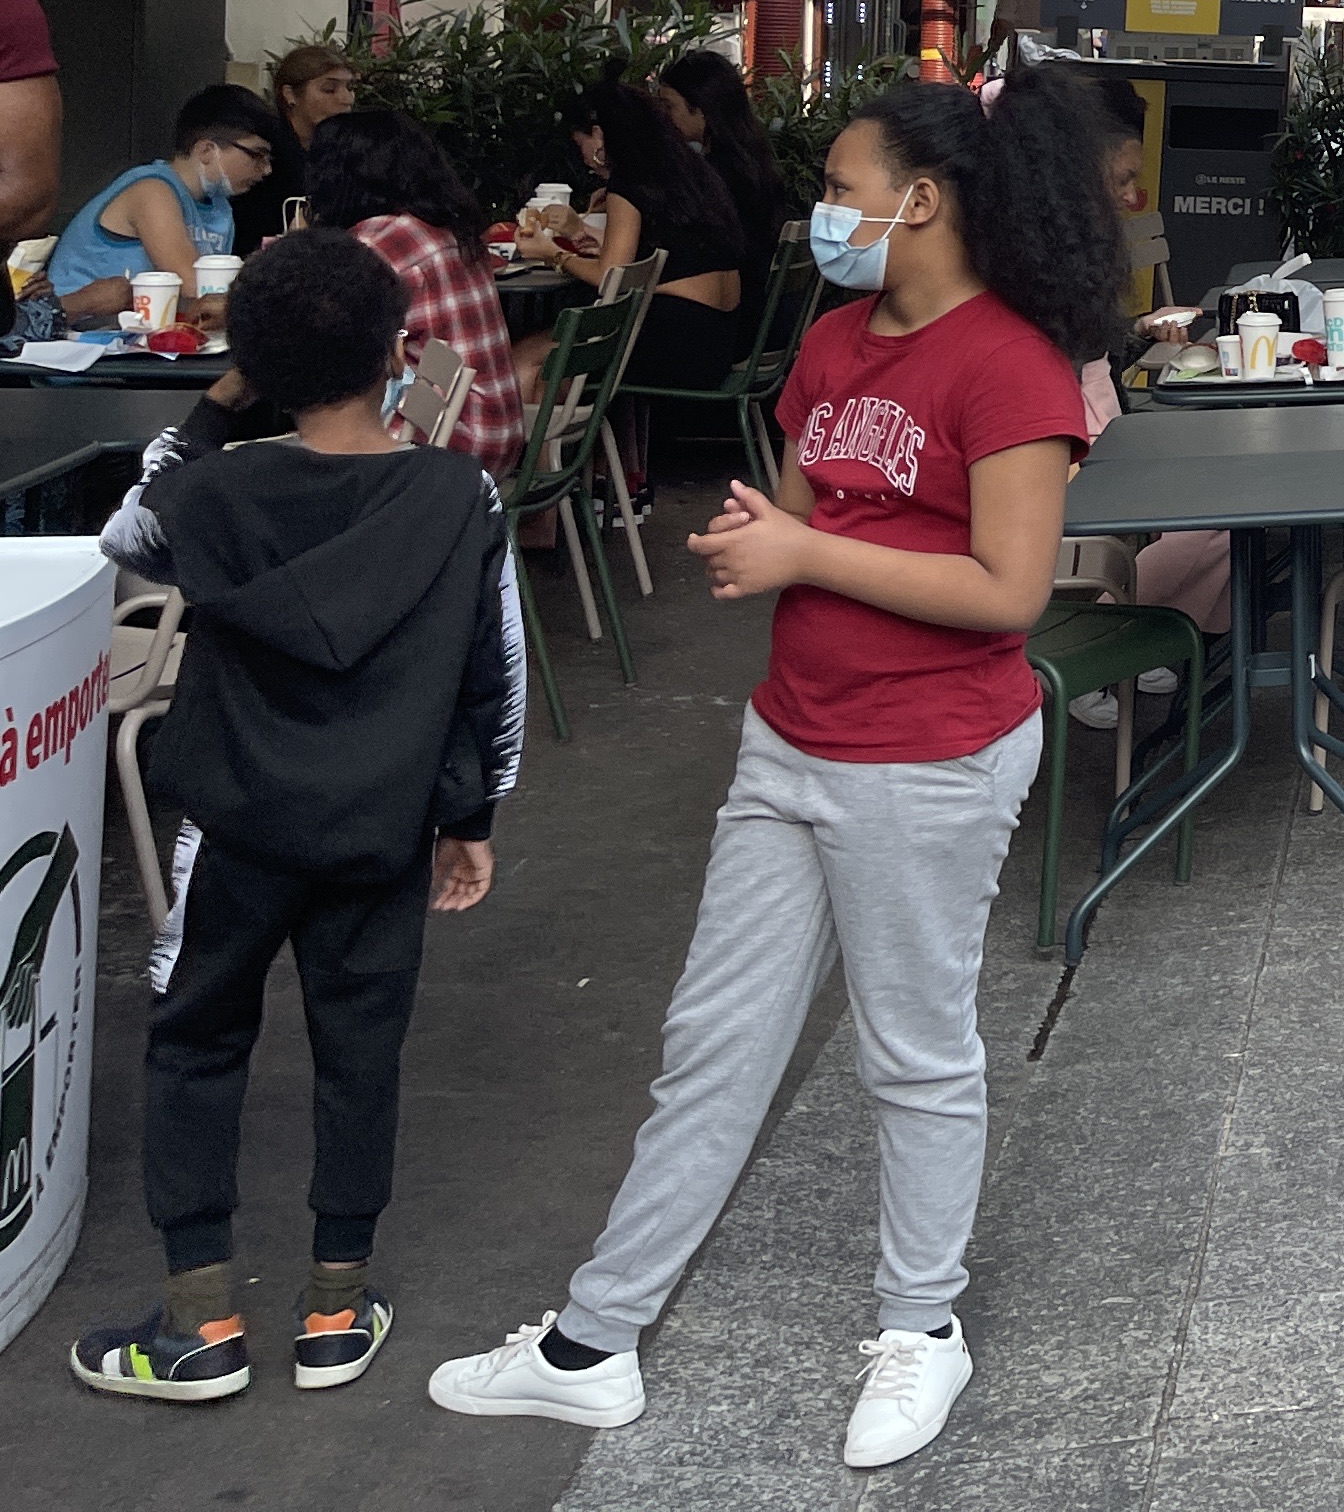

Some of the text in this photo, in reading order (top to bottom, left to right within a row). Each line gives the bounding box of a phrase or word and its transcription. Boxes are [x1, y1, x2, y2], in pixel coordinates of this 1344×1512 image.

[1173, 195, 1251, 215] MERCI
[822, 396, 926, 497] ANGELES
[0, 706, 18, 787] à
